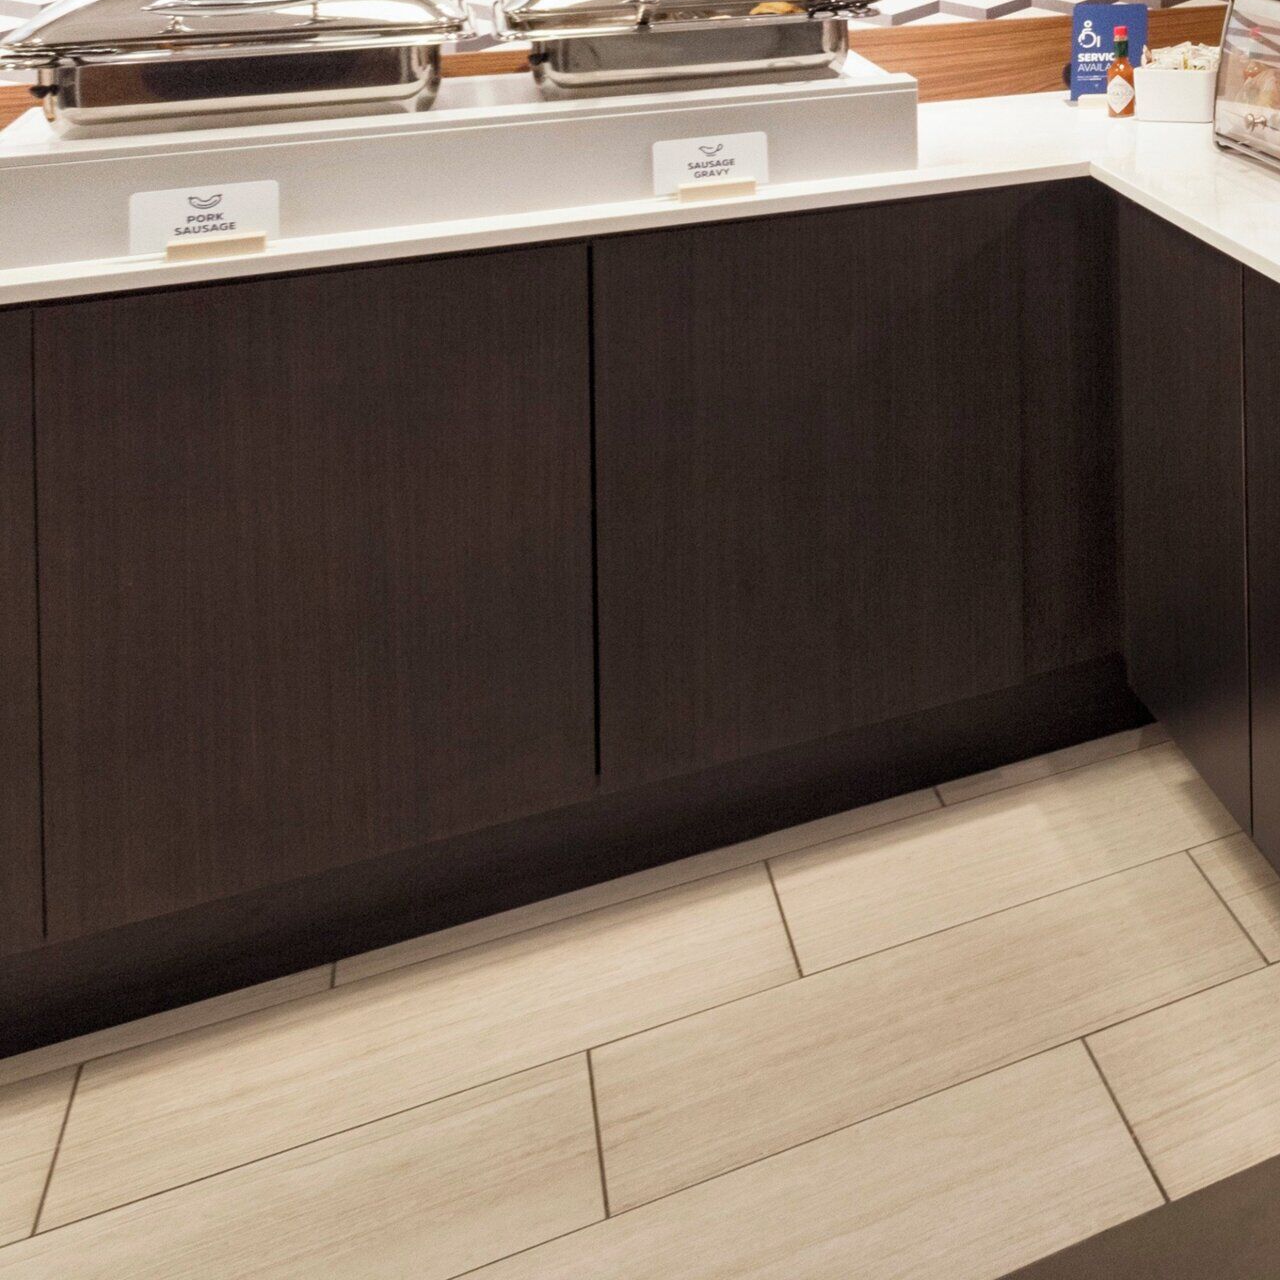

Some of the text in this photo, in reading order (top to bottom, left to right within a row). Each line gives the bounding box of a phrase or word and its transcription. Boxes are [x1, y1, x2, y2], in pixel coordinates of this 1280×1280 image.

[1077, 52, 1116, 63] SERVIC
[1077, 62, 1111, 72] AVAILA
[687, 158, 736, 170] SAUSAGE
[693, 168, 731, 179] GRAVY
[186, 212, 225, 224] PORK
[174, 221, 237, 236] SAUSAGE
